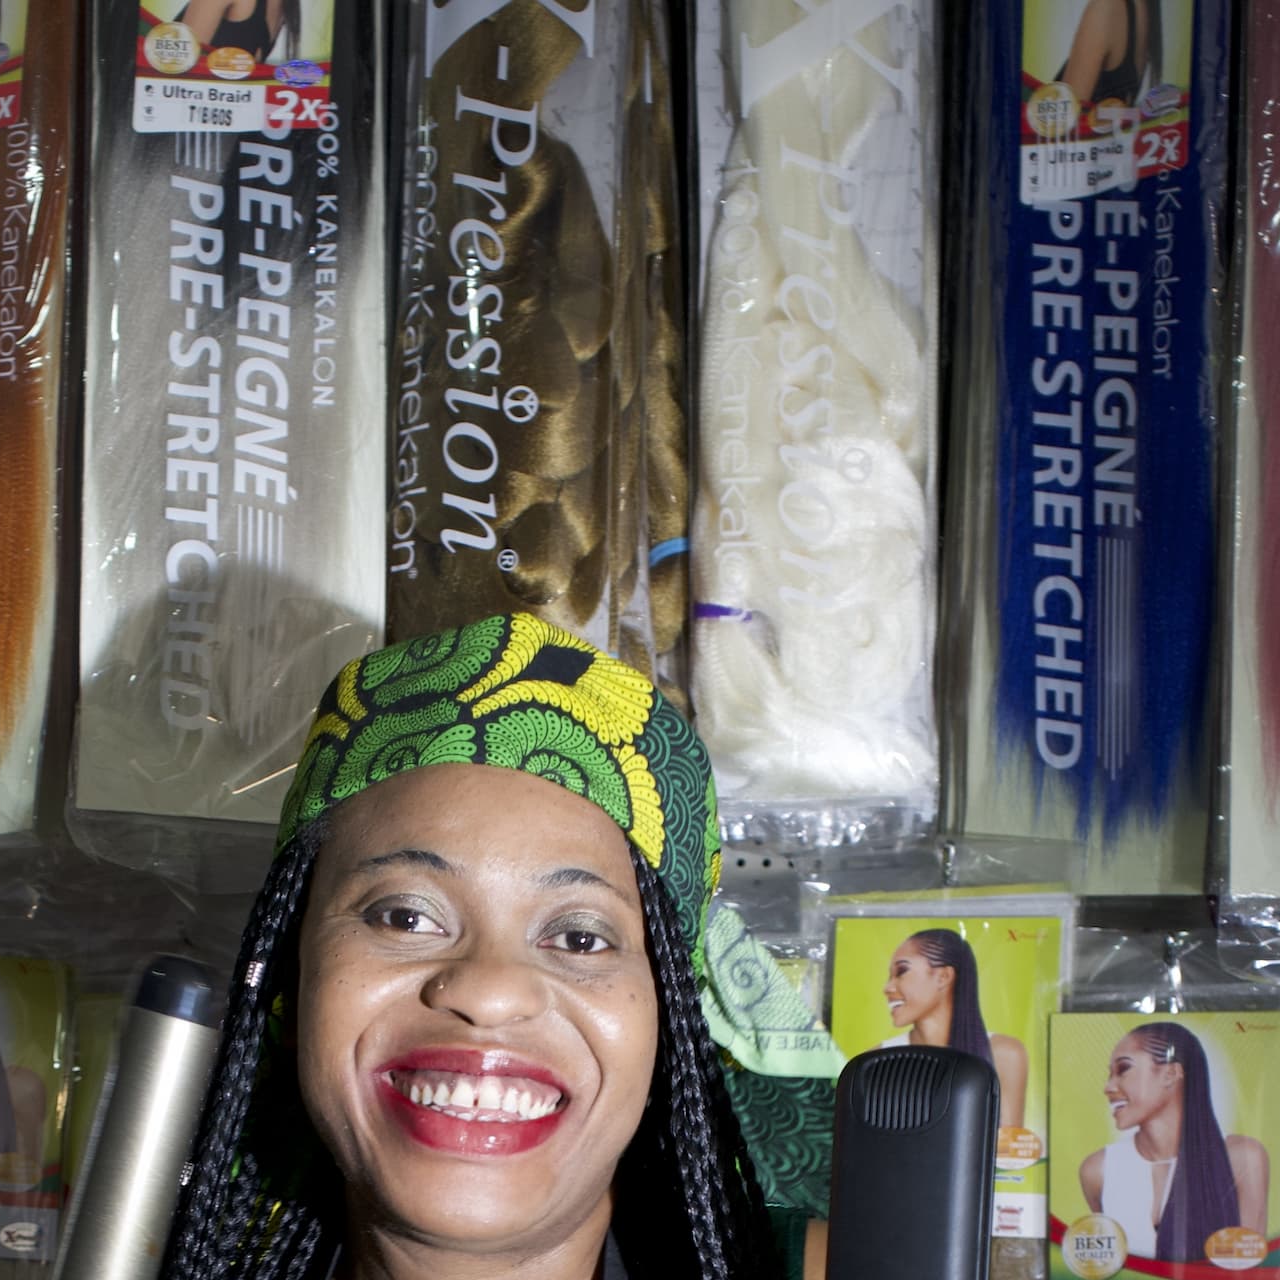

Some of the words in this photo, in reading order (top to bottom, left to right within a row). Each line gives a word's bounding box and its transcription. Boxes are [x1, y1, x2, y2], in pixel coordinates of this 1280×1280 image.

[155, 39, 190, 50] BEST
[163, 85, 203, 99] Ultra
[208, 88, 252, 103] Braid
[271, 91, 320, 121] 2x
[317, 102, 340, 178] 100%
[1138, 131, 1181, 168] 2x
[313, 194, 340, 407] KANEKALON
[1152, 186, 1184, 376] Kanekalon
[160, 174, 225, 733] PRE-STRETCHED
[387, 284, 436, 574] Kanekalon
[719, 336, 761, 612] Kanekalo
[1030, 200, 1085, 772] PRE-STRETCHED
[1075, 1237, 1115, 1250] BEST
